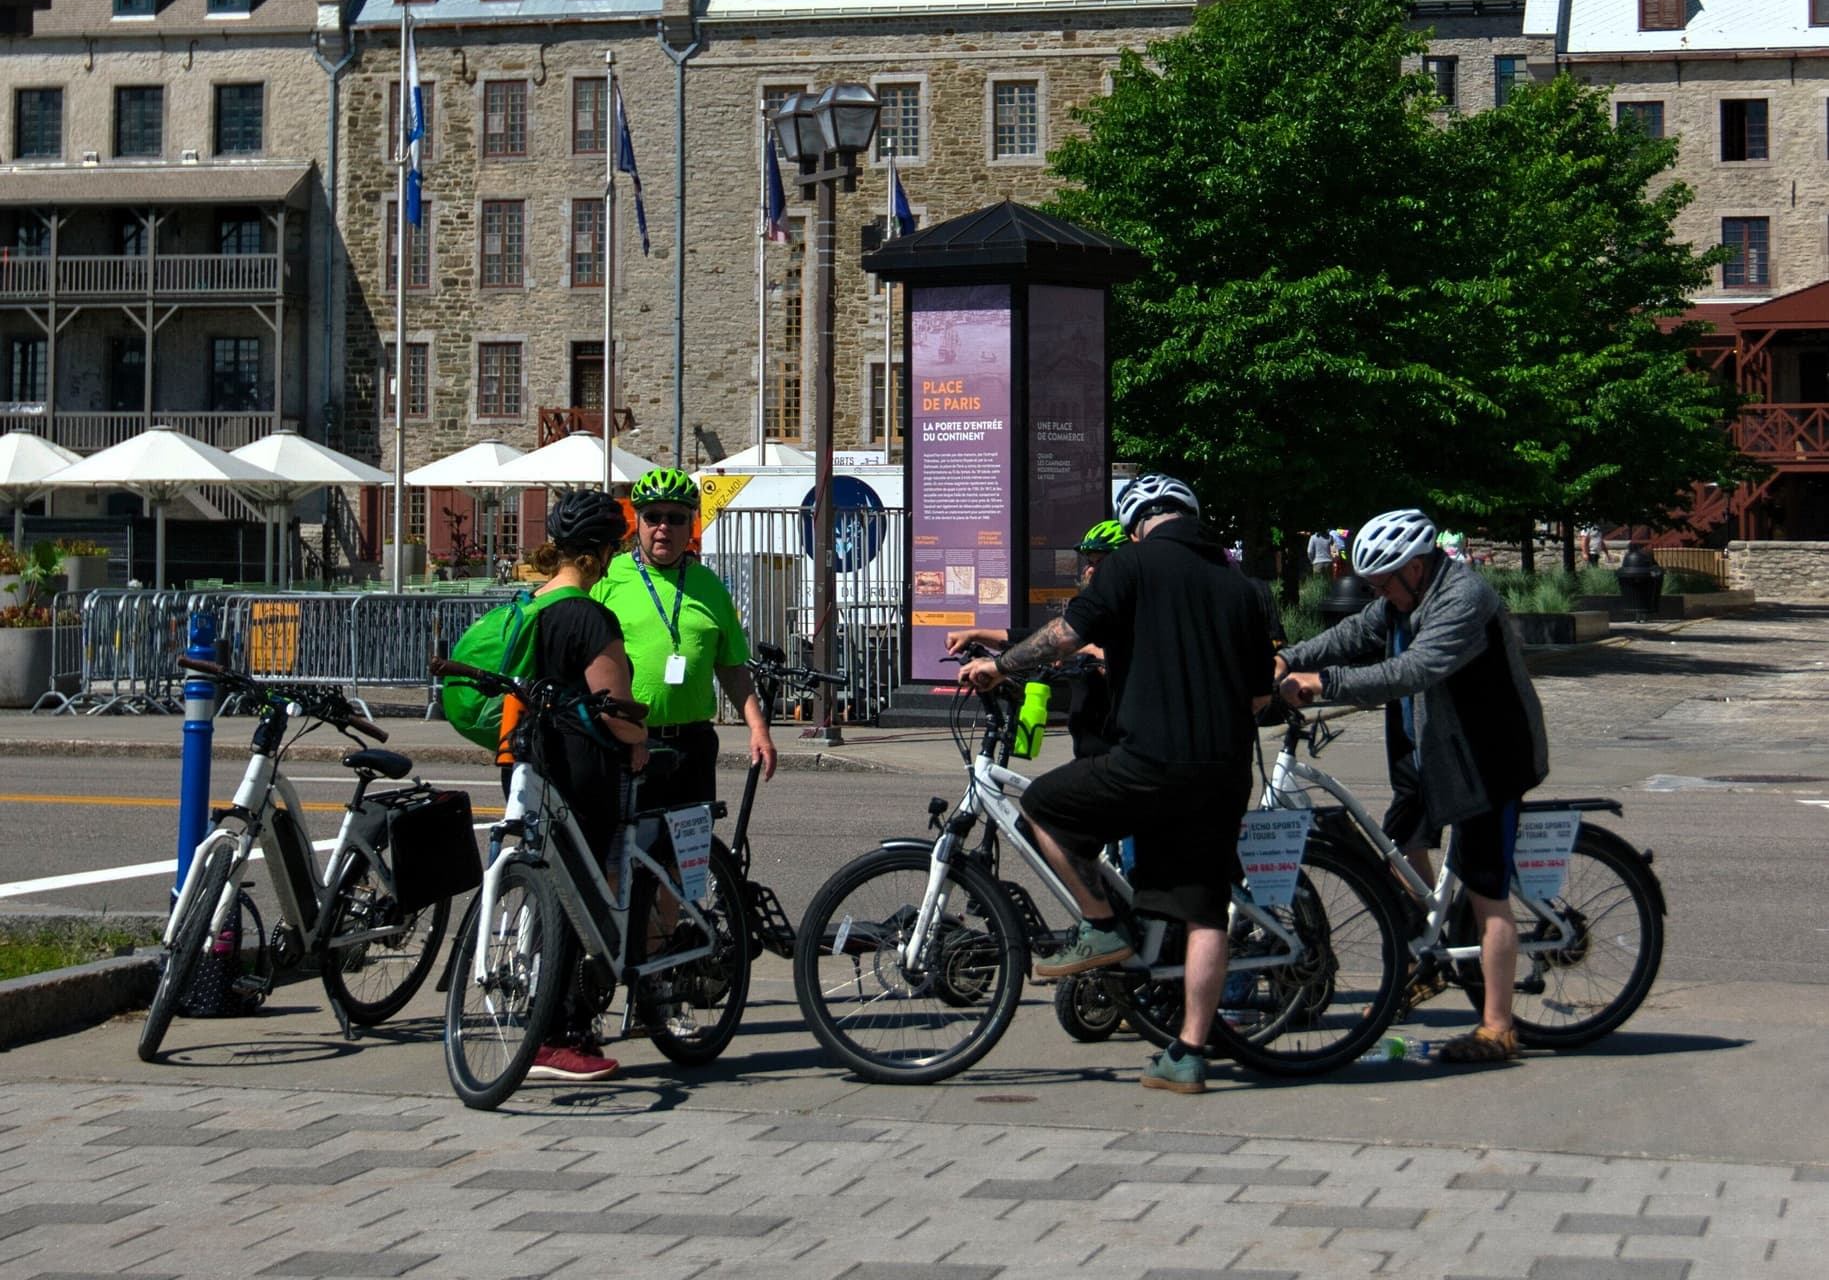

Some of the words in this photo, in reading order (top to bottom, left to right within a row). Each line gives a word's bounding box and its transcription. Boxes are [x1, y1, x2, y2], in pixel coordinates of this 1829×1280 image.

[923, 381, 963, 394] PLACE
[923, 398, 940, 410] DE
[944, 397, 981, 410] PARIS
[923, 422, 934, 431] LA
[935, 422, 962, 431] PORTE
[963, 418, 1003, 430] D'ENTRÉE
[1037, 421, 1052, 431] UNE
[1053, 422, 1073, 431] PLACE
[923, 433, 936, 441] DU
[937, 432, 985, 441] CONTINENT
[1037, 432, 1047, 440] DE
[1048, 432, 1085, 441] COMMERCE
[1273, 821, 1301, 830] SPORTS
[1544, 821, 1571, 829] SPORTS
[1252, 831, 1276, 840] TOURS
